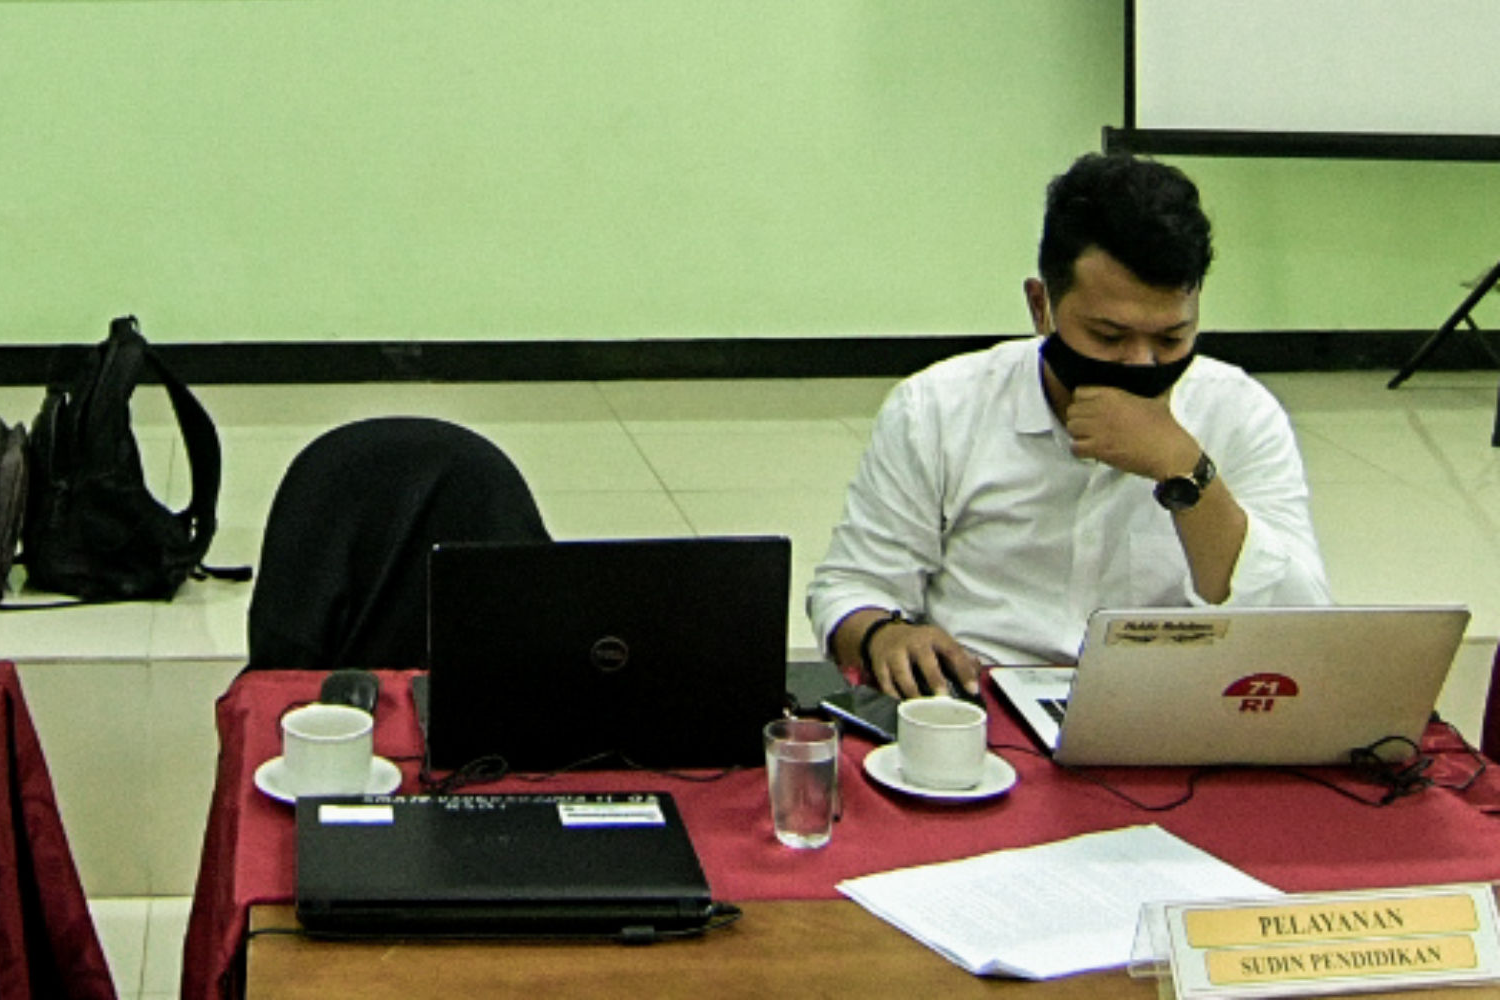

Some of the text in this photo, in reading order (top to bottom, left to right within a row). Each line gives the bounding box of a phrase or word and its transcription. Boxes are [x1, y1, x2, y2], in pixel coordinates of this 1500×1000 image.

[1248, 680, 1280, 696] 71
[1238, 699, 1275, 712] RI
[1258, 908, 1404, 937] PELAYANAN
[1241, 947, 1441, 975] SUDIN PENDIDIKAN
